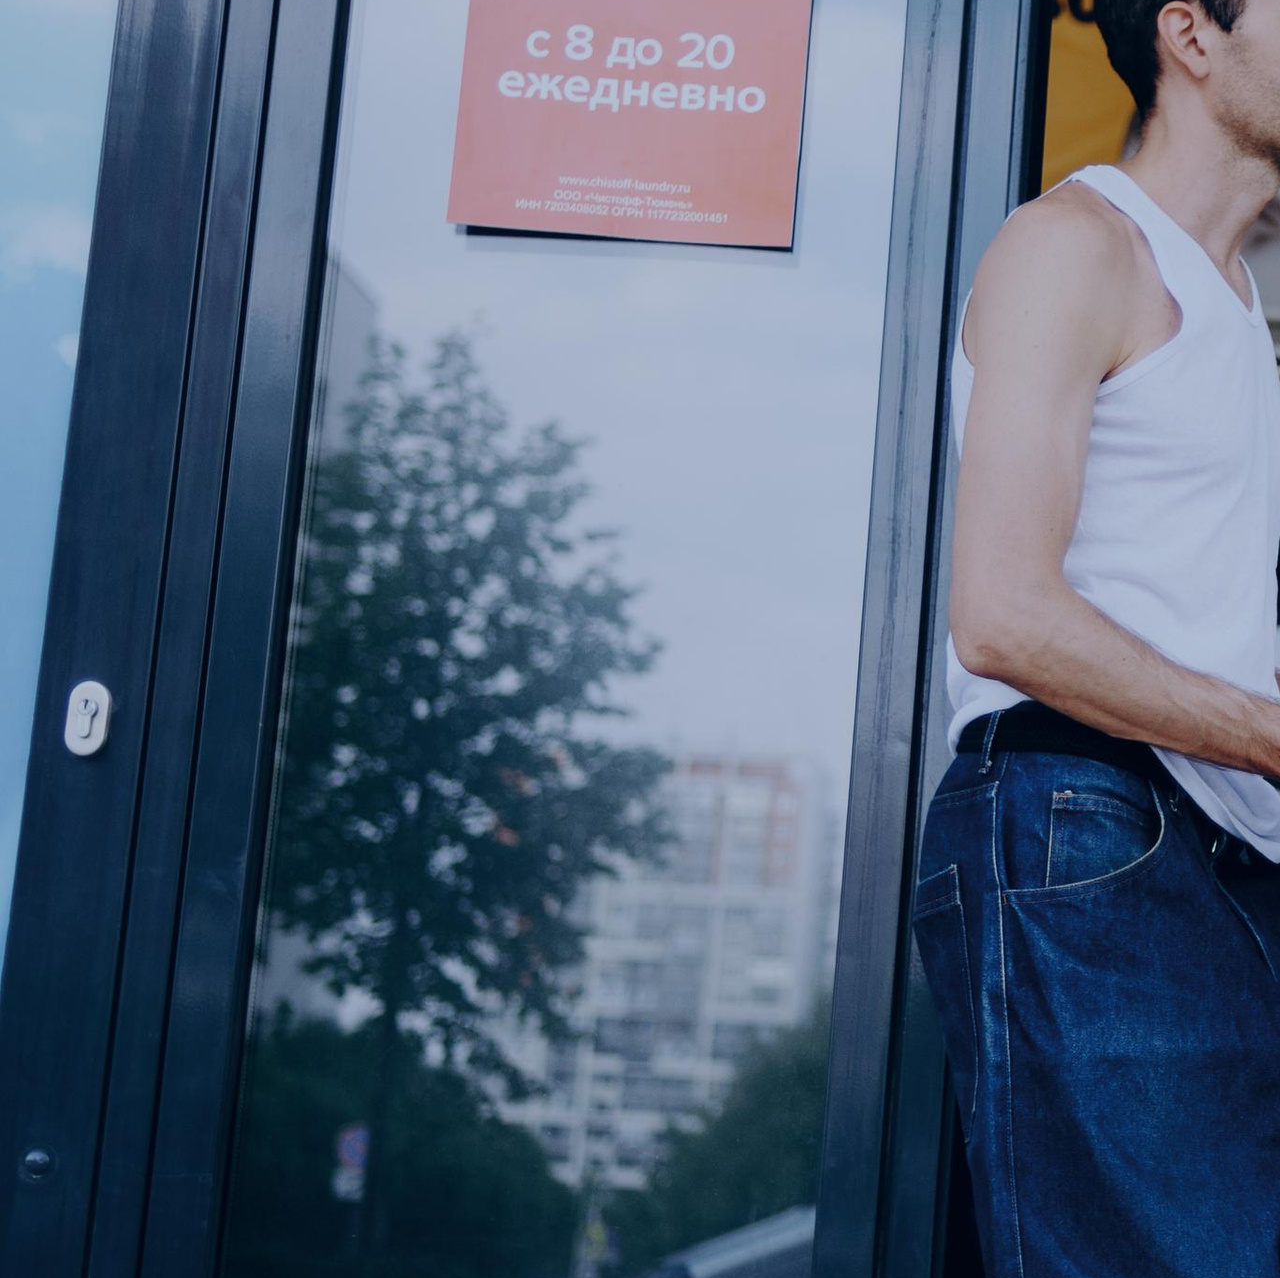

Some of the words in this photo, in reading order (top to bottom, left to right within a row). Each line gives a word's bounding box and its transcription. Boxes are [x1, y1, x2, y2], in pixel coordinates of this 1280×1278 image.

[525, 29, 549, 58] с
[565, 23, 594, 60] 8
[606, 35, 663, 70] до
[676, 32, 735, 70] 20
[498, 69, 766, 114] ежедневно
[558, 175, 691, 193] www.chistoff-laundry.ru
[553, 189, 581, 200] ООО
[514, 198, 540, 210] ИНН
[612, 206, 643, 218] ОГРН
